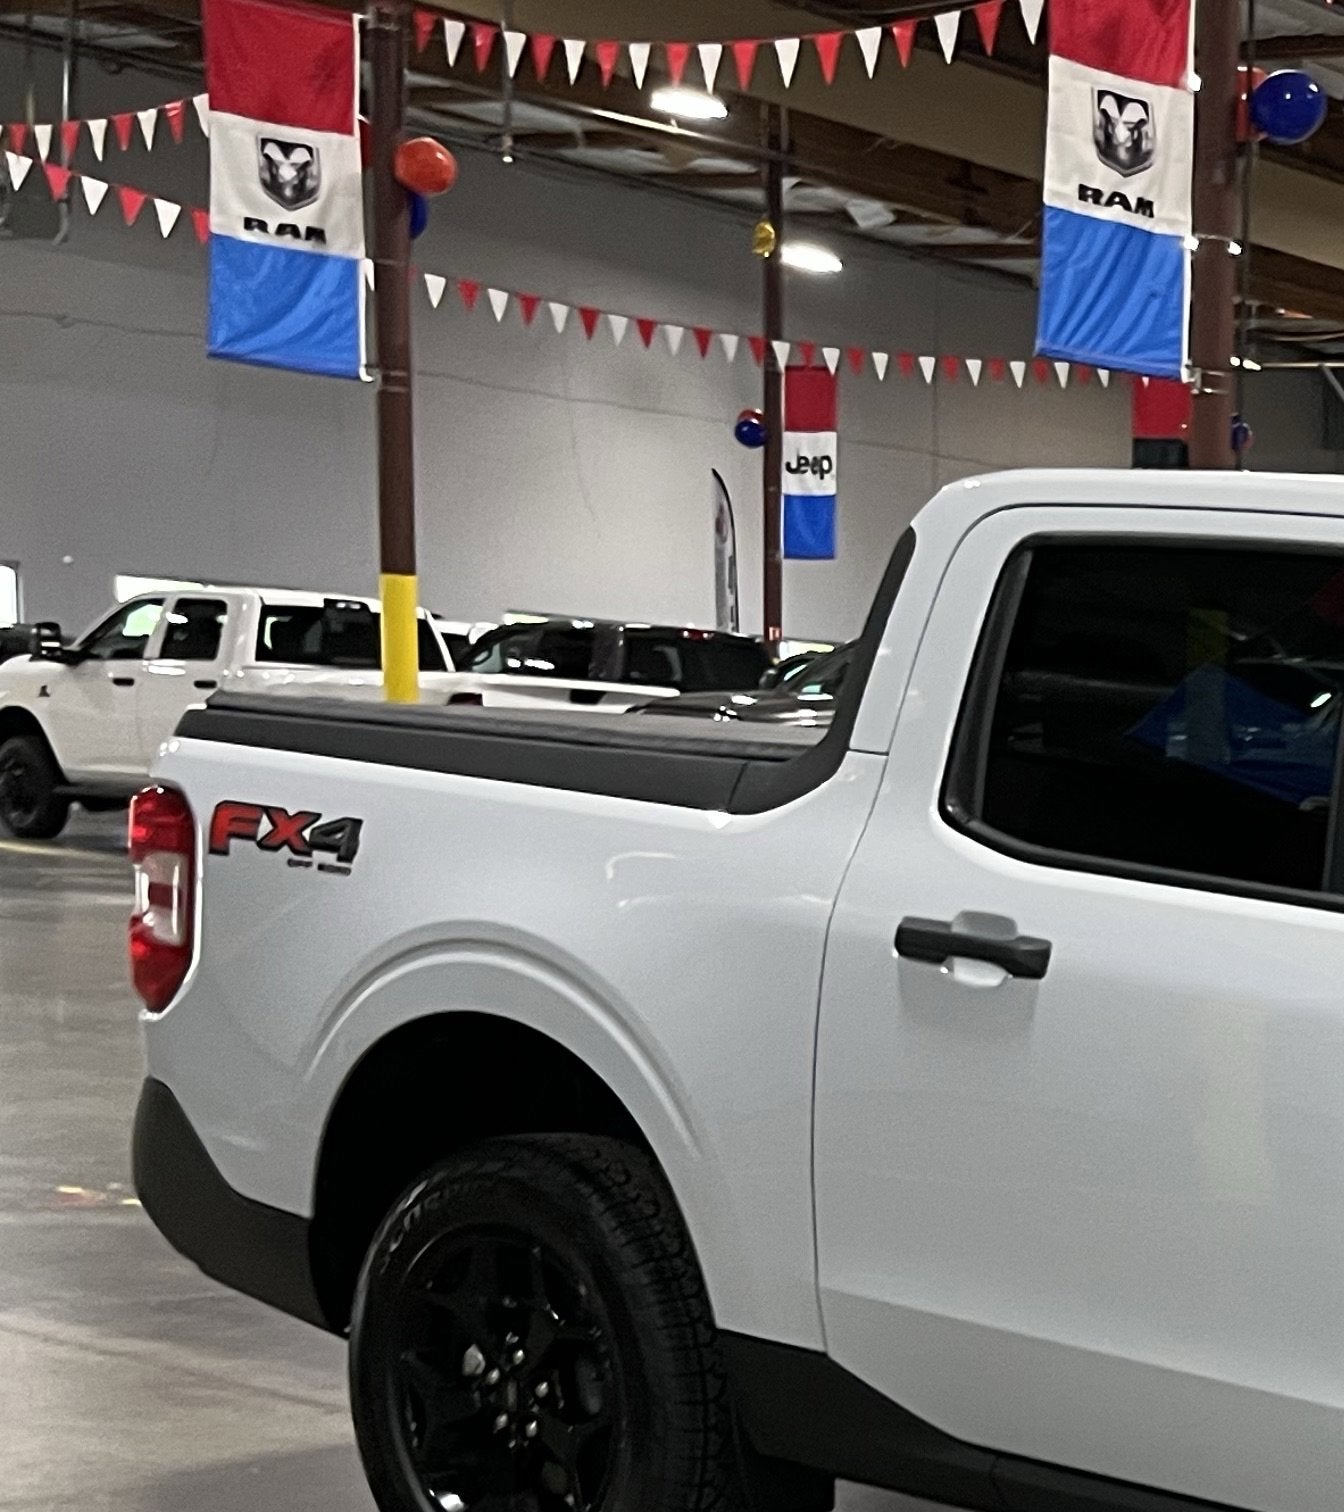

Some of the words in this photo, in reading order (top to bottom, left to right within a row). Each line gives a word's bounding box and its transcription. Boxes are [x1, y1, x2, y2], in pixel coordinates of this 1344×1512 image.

[1078, 183, 1154, 218] RAM
[243, 216, 327, 245] RAM
[785, 448, 832, 480] Jeep
[208, 800, 364, 863] FX4
